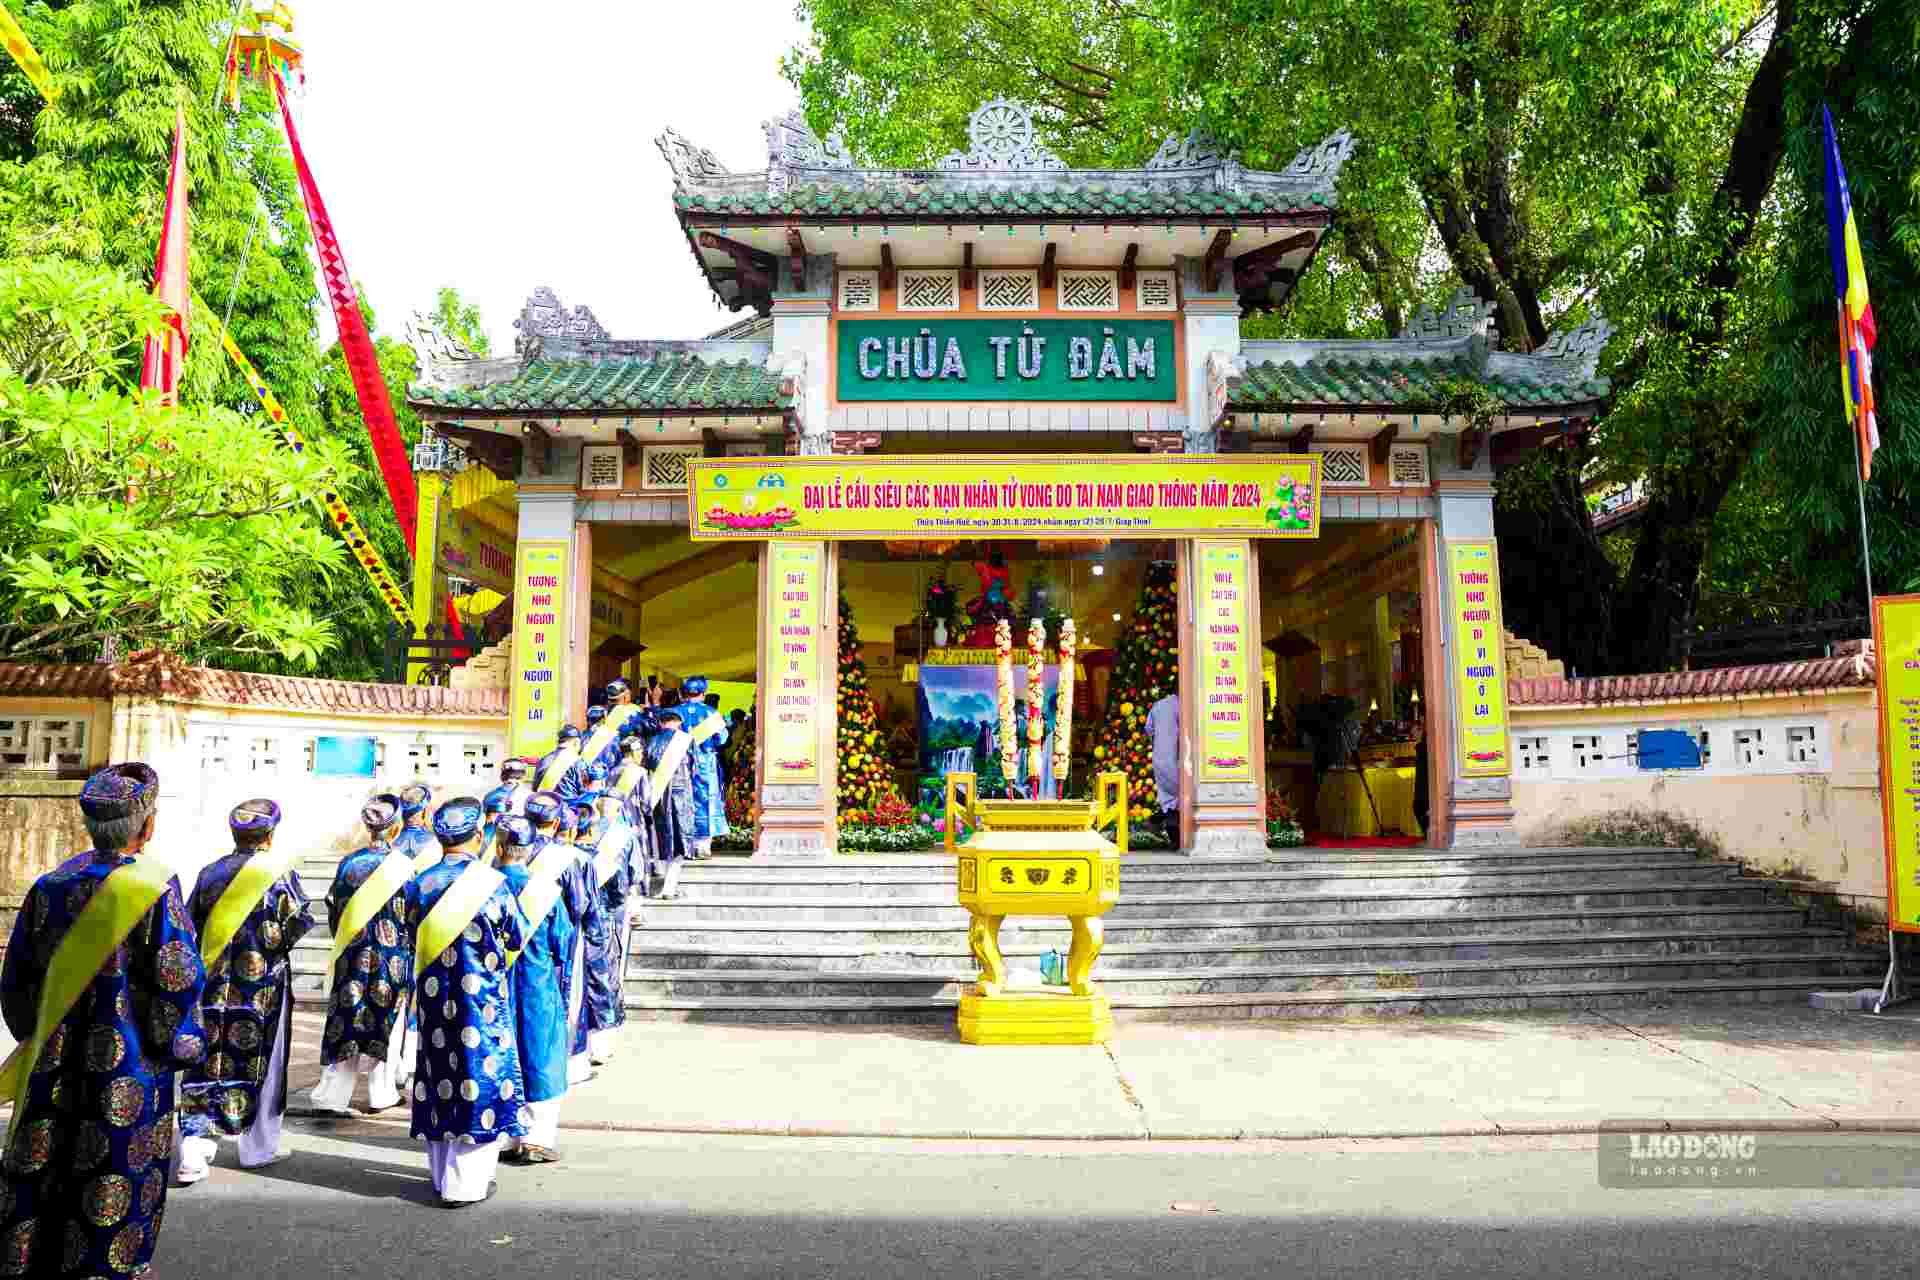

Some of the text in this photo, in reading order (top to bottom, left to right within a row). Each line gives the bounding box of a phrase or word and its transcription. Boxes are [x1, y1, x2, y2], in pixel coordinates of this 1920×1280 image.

[858, 326, 968, 380] CHÙA
[988, 321, 1047, 379] TỪ
[1020, 484, 1053, 508] VONG
[1056, 484, 1072, 508] DO
[1076, 484, 1094, 508] TAI
[1127, 484, 1154, 508] GIAO
[1158, 479, 1197, 508] THÔNG
[1232, 484, 1261, 507] 2024
